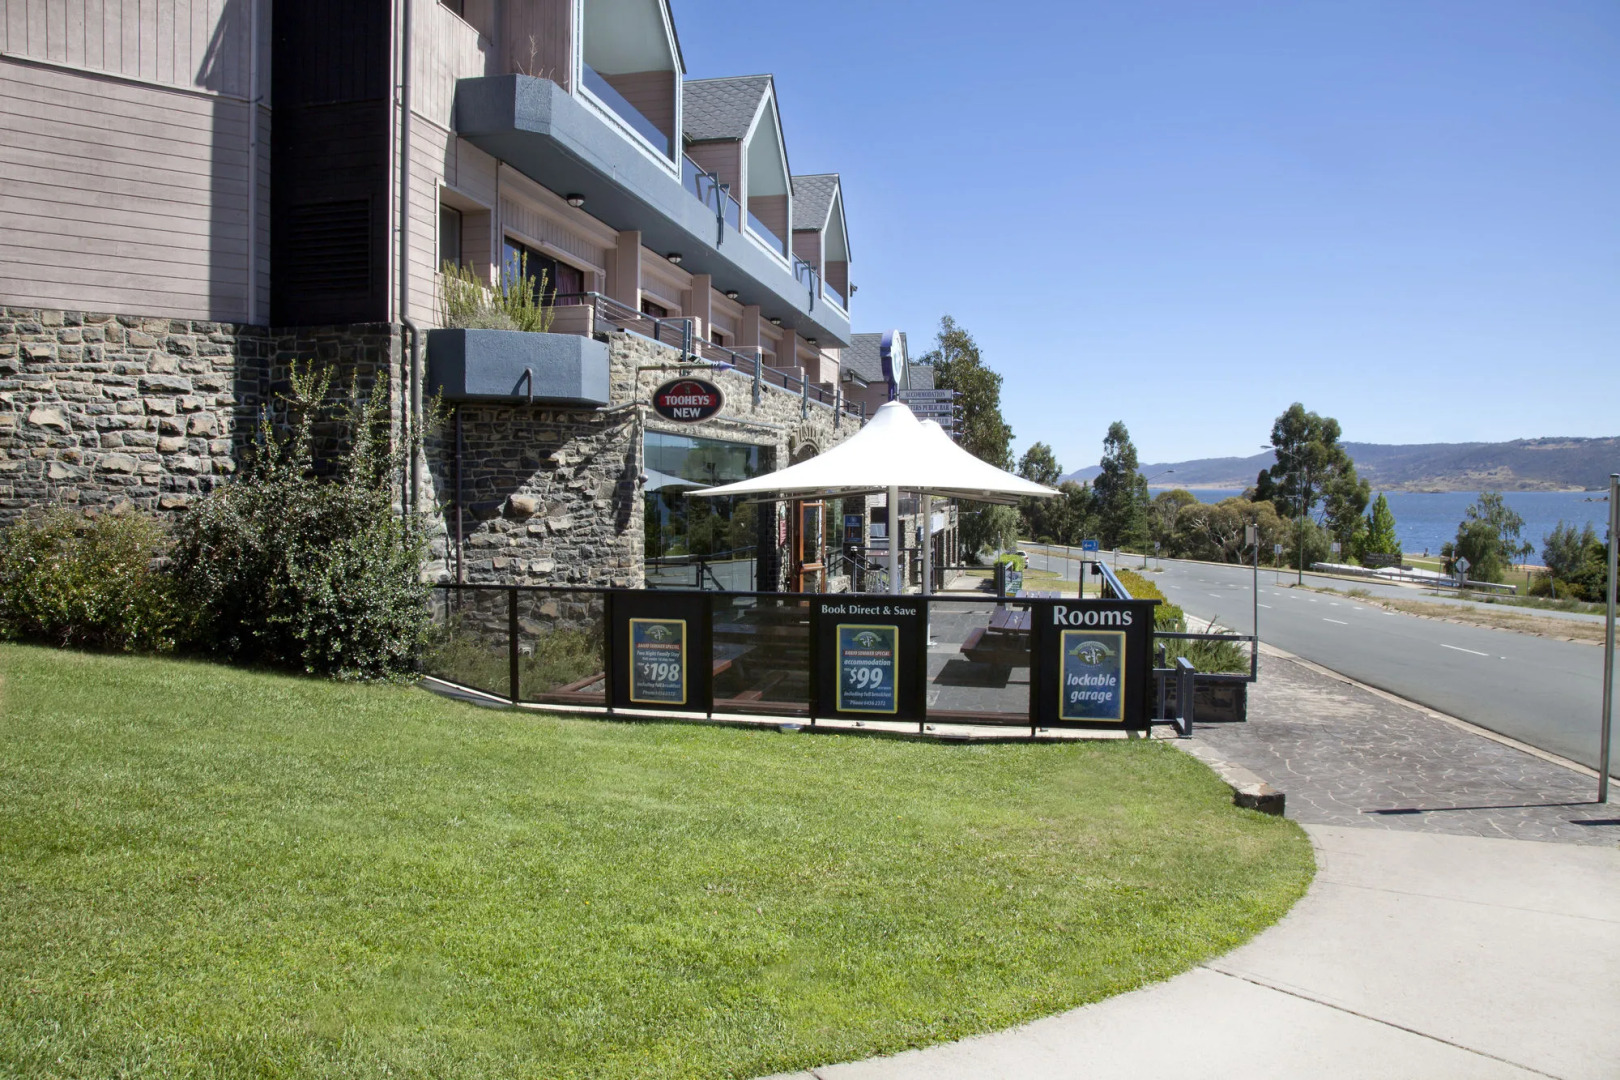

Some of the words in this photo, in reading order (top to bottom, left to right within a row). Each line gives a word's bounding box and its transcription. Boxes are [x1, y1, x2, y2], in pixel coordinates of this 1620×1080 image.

[665, 395, 709, 406] TOOHEYS
[673, 407, 701, 418] NEW
[821, 604, 846, 614] Book
[849, 605, 880, 615] Direct
[882, 606, 891, 615] &
[894, 606, 917, 616] Save
[1053, 605, 1133, 626] Rooms
[844, 658, 891, 666] accommodation
[643, 663, 680, 682] $198
[849, 667, 883, 689] $99
[1067, 673, 1117, 686] lockable
[1070, 690, 1113, 703] garage
